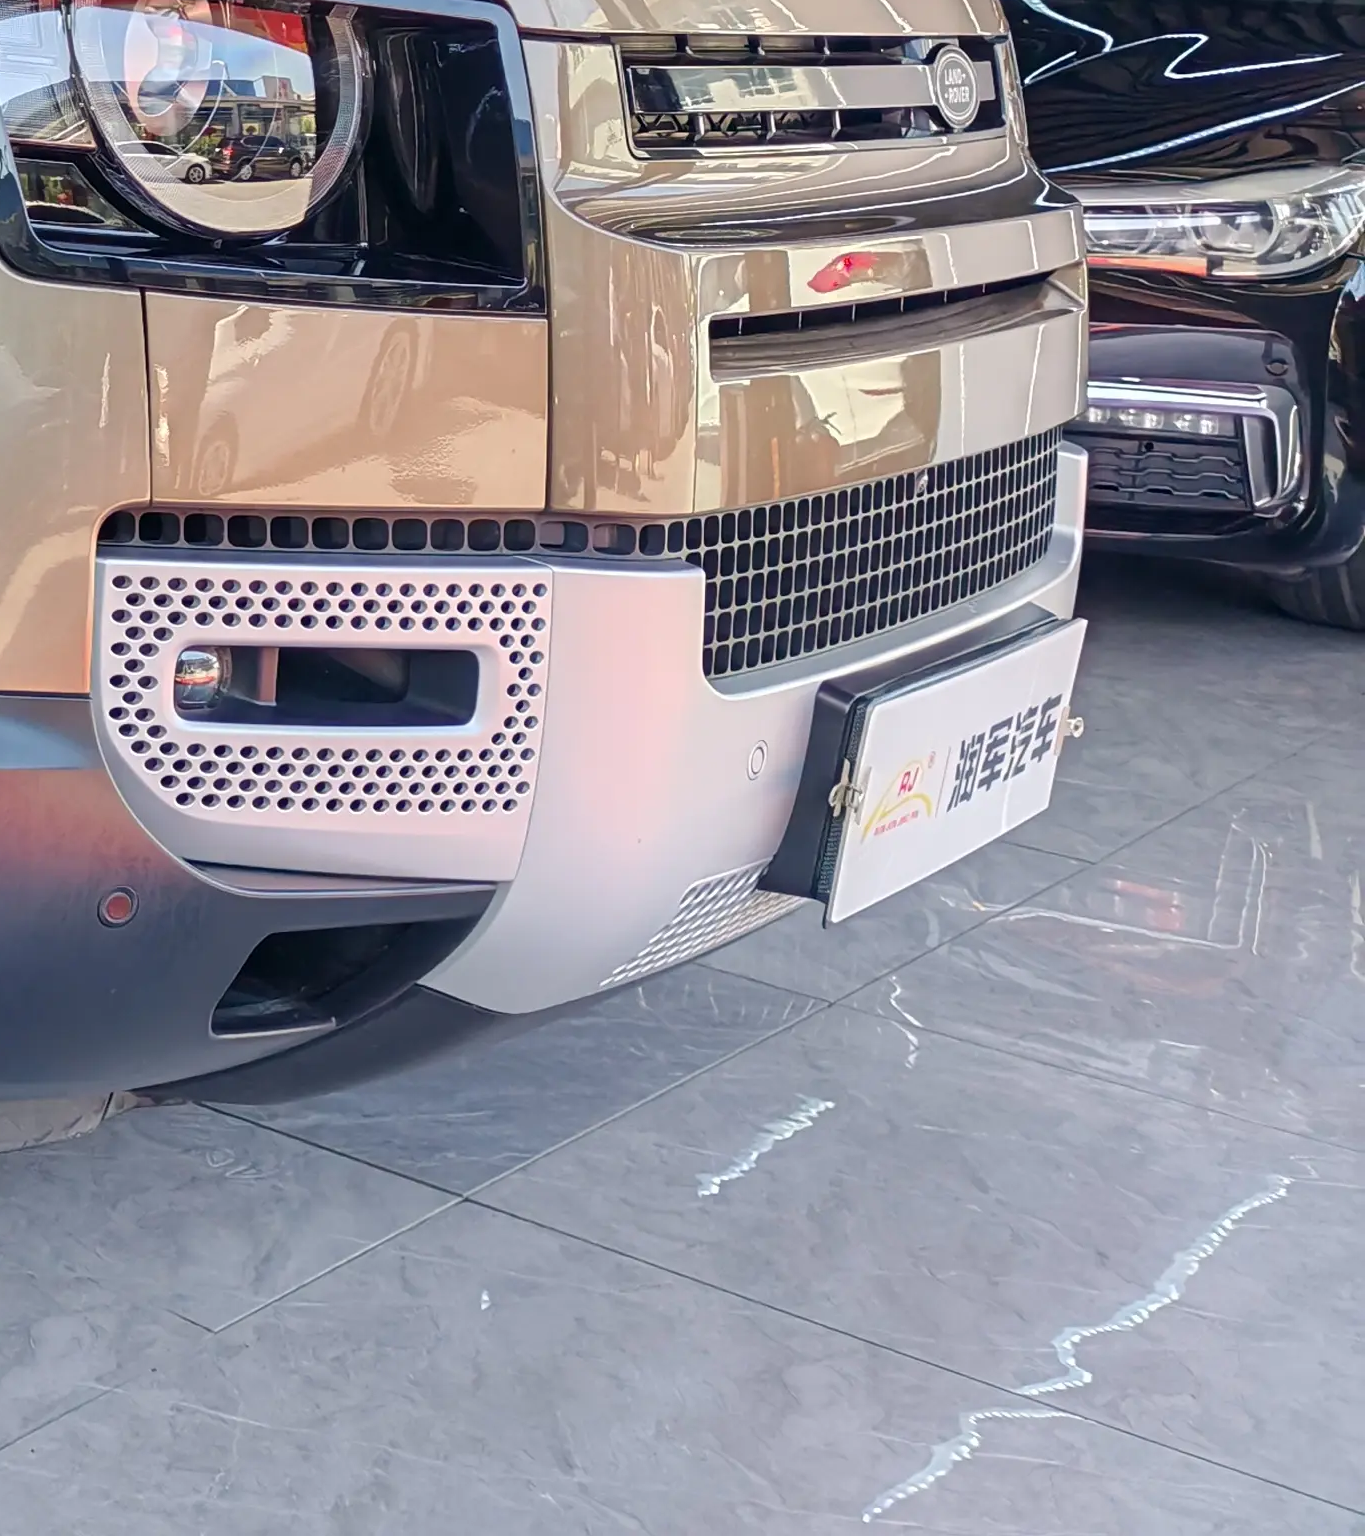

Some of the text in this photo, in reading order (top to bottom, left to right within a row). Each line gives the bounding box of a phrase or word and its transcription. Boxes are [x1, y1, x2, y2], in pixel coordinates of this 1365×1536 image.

[944, 68, 963, 85] LAND
[948, 86, 970, 103] ROVER
[946, 693, 1063, 814] 润军汽车
